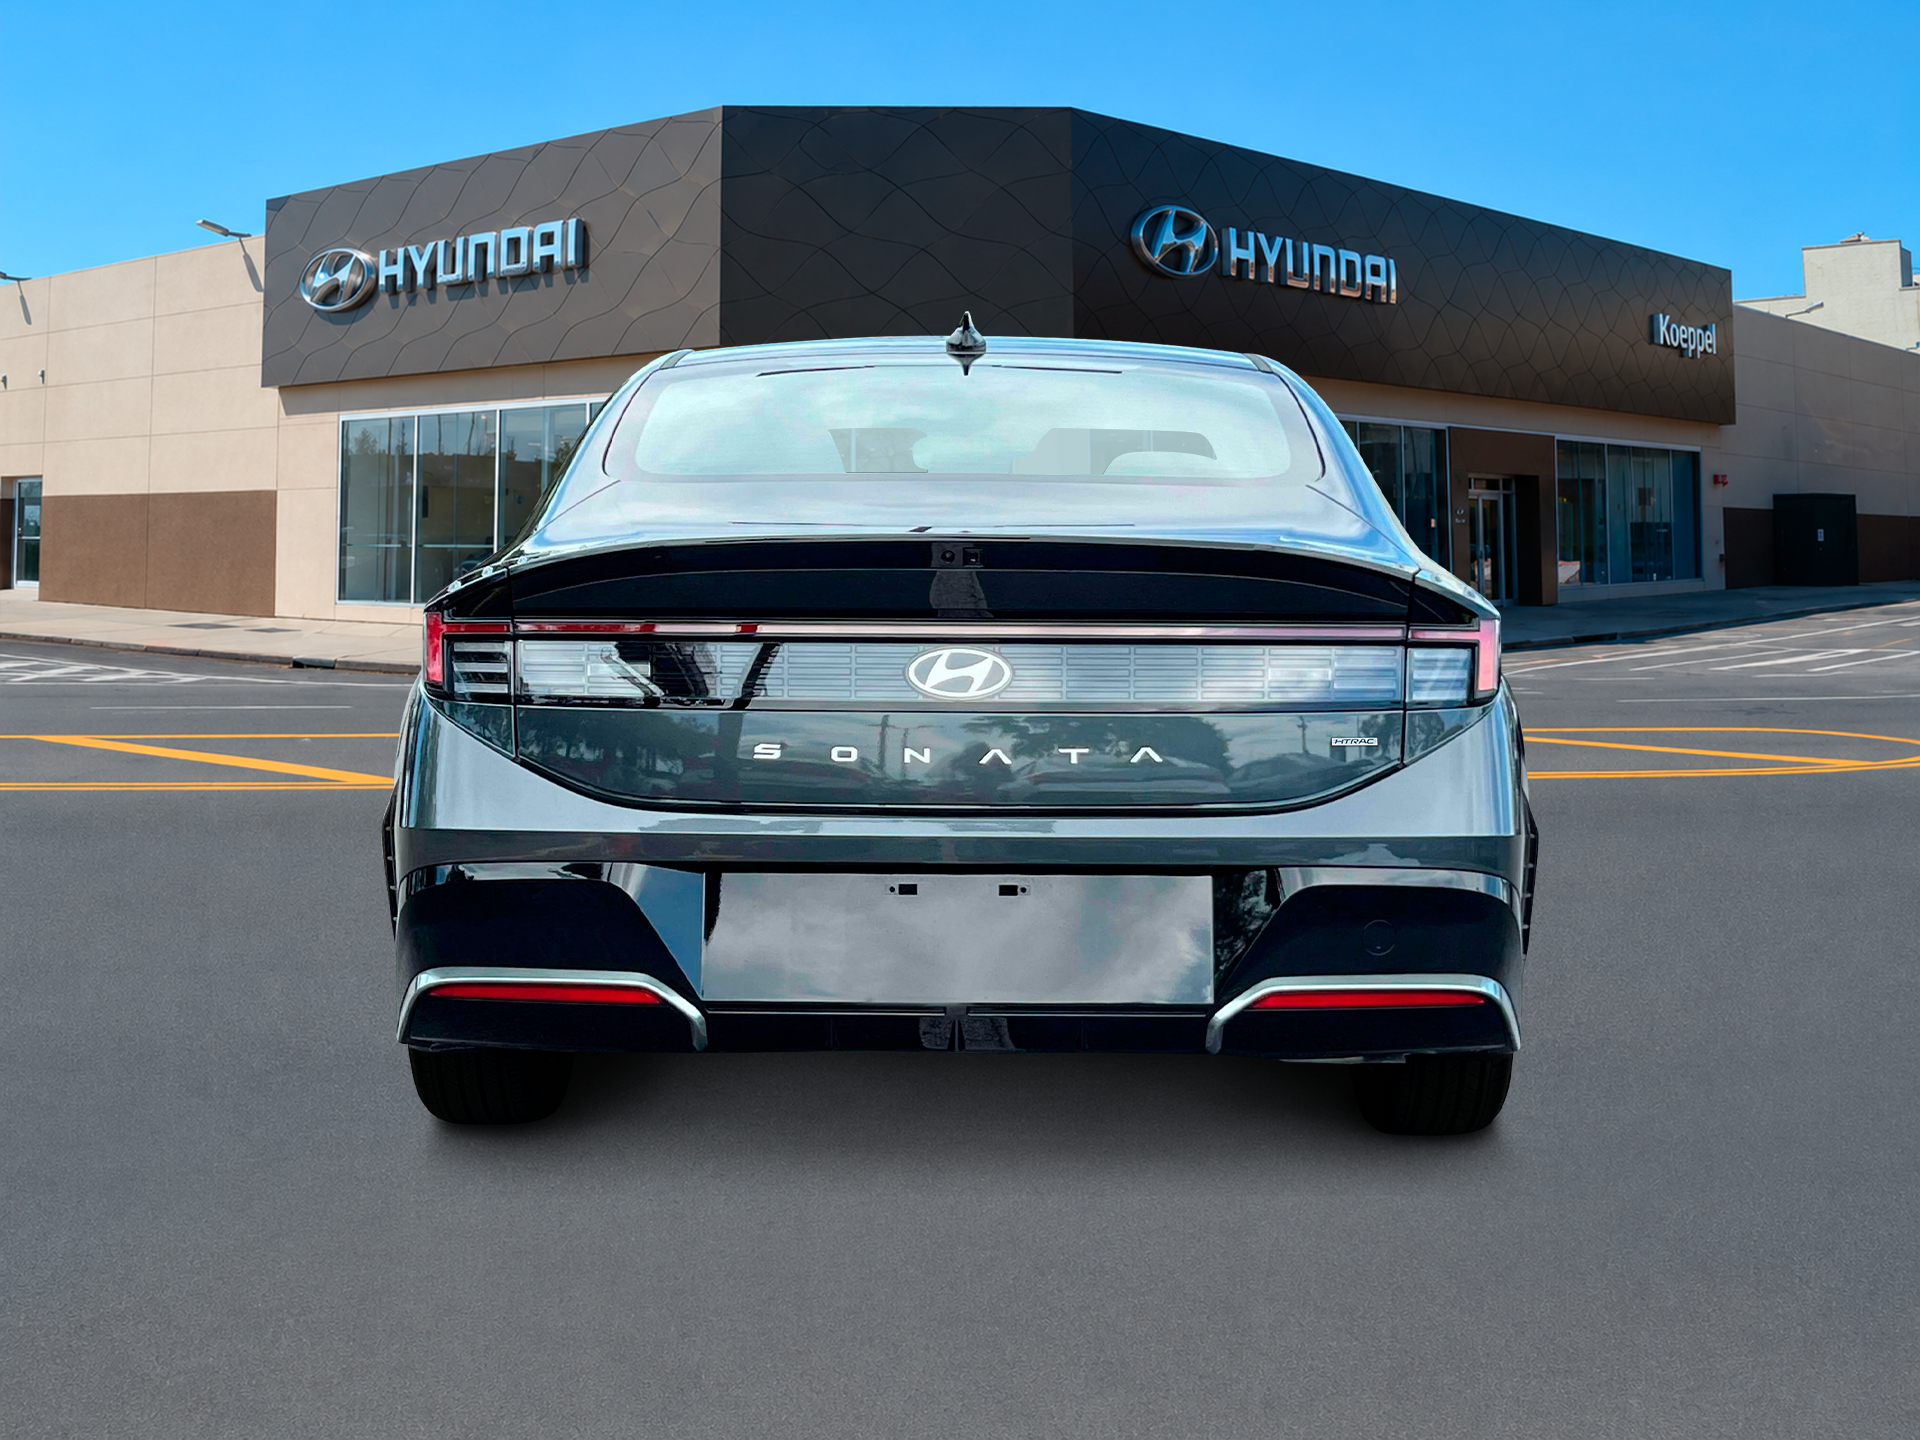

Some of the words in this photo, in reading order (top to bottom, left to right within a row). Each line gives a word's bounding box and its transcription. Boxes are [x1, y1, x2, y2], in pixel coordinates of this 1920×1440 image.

[378, 217, 584, 293] HYUNDAI
[1224, 227, 1397, 304] HYUNDAI
[1655, 312, 1717, 359] Koeppel
[752, 743, 1163, 764] SONATA
[1333, 737, 1375, 746] HTRAC
